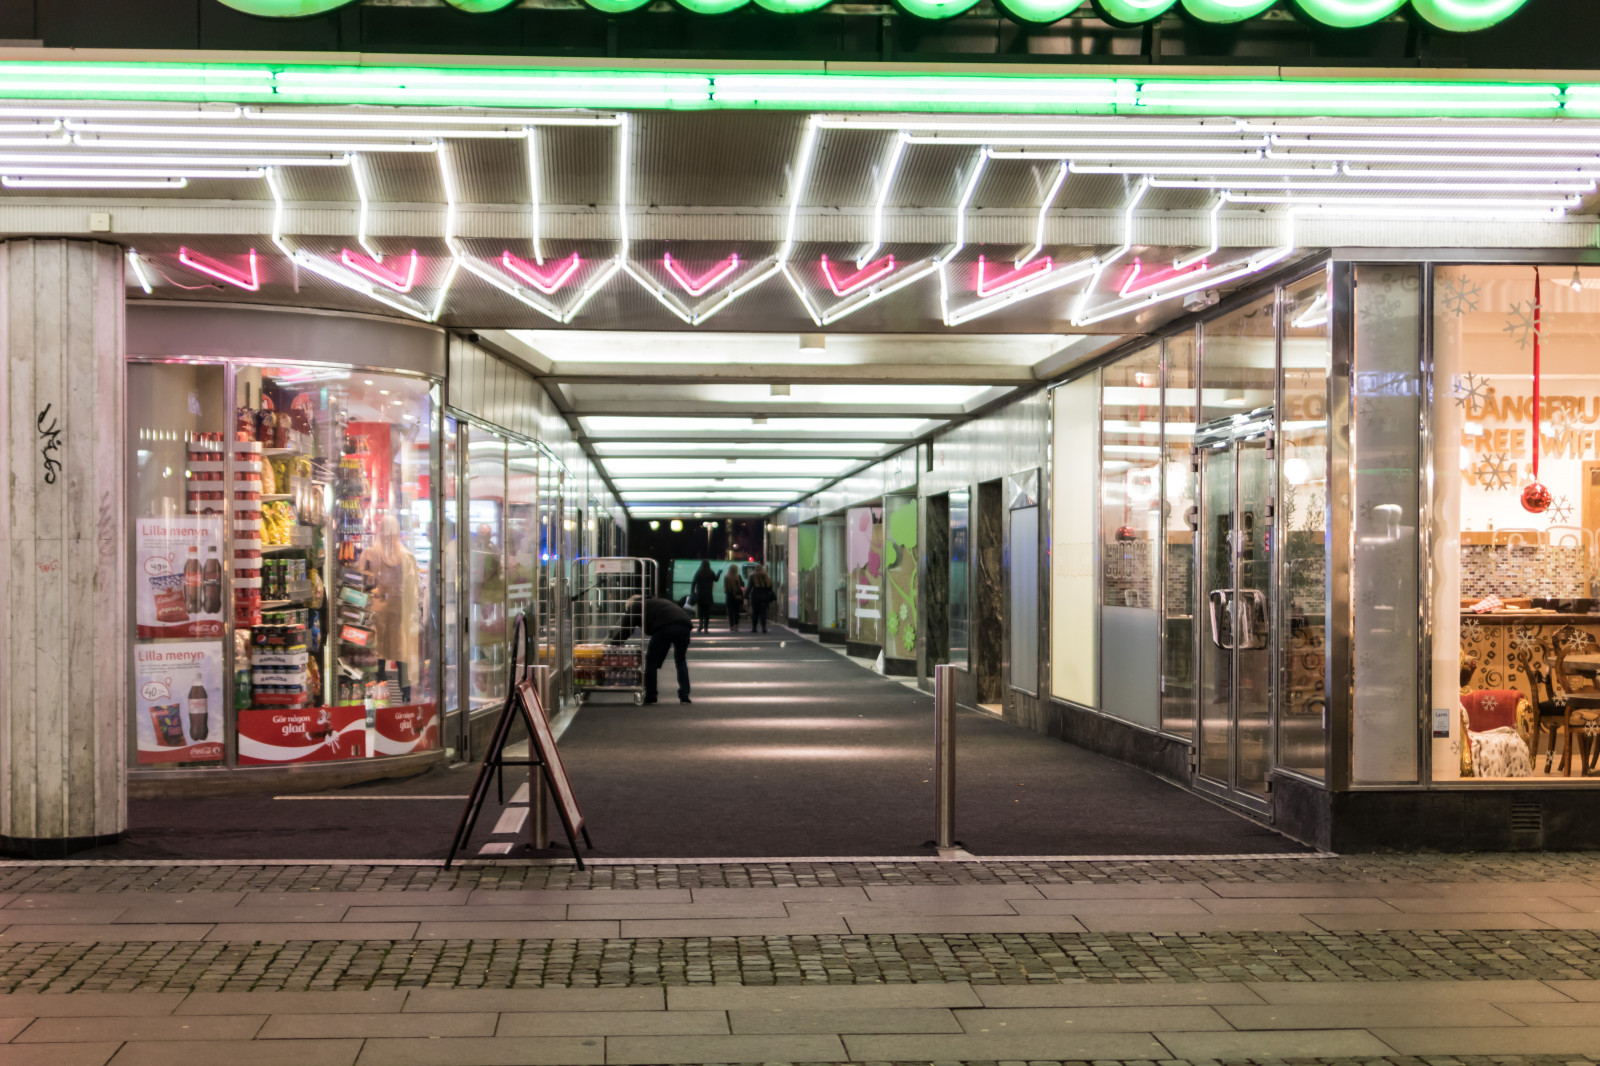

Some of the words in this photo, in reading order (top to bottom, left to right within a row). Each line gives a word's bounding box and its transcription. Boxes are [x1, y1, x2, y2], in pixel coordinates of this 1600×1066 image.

[142, 525, 167, 536] Lilla
[169, 527, 209, 538] menyn
[138, 650, 163, 661] Lilla
[165, 650, 205, 663] menyn
[272, 714, 287, 723] Gör
[288, 714, 311, 724] någon
[399, 719, 412, 731] glad
[281, 723, 306, 736] glad
